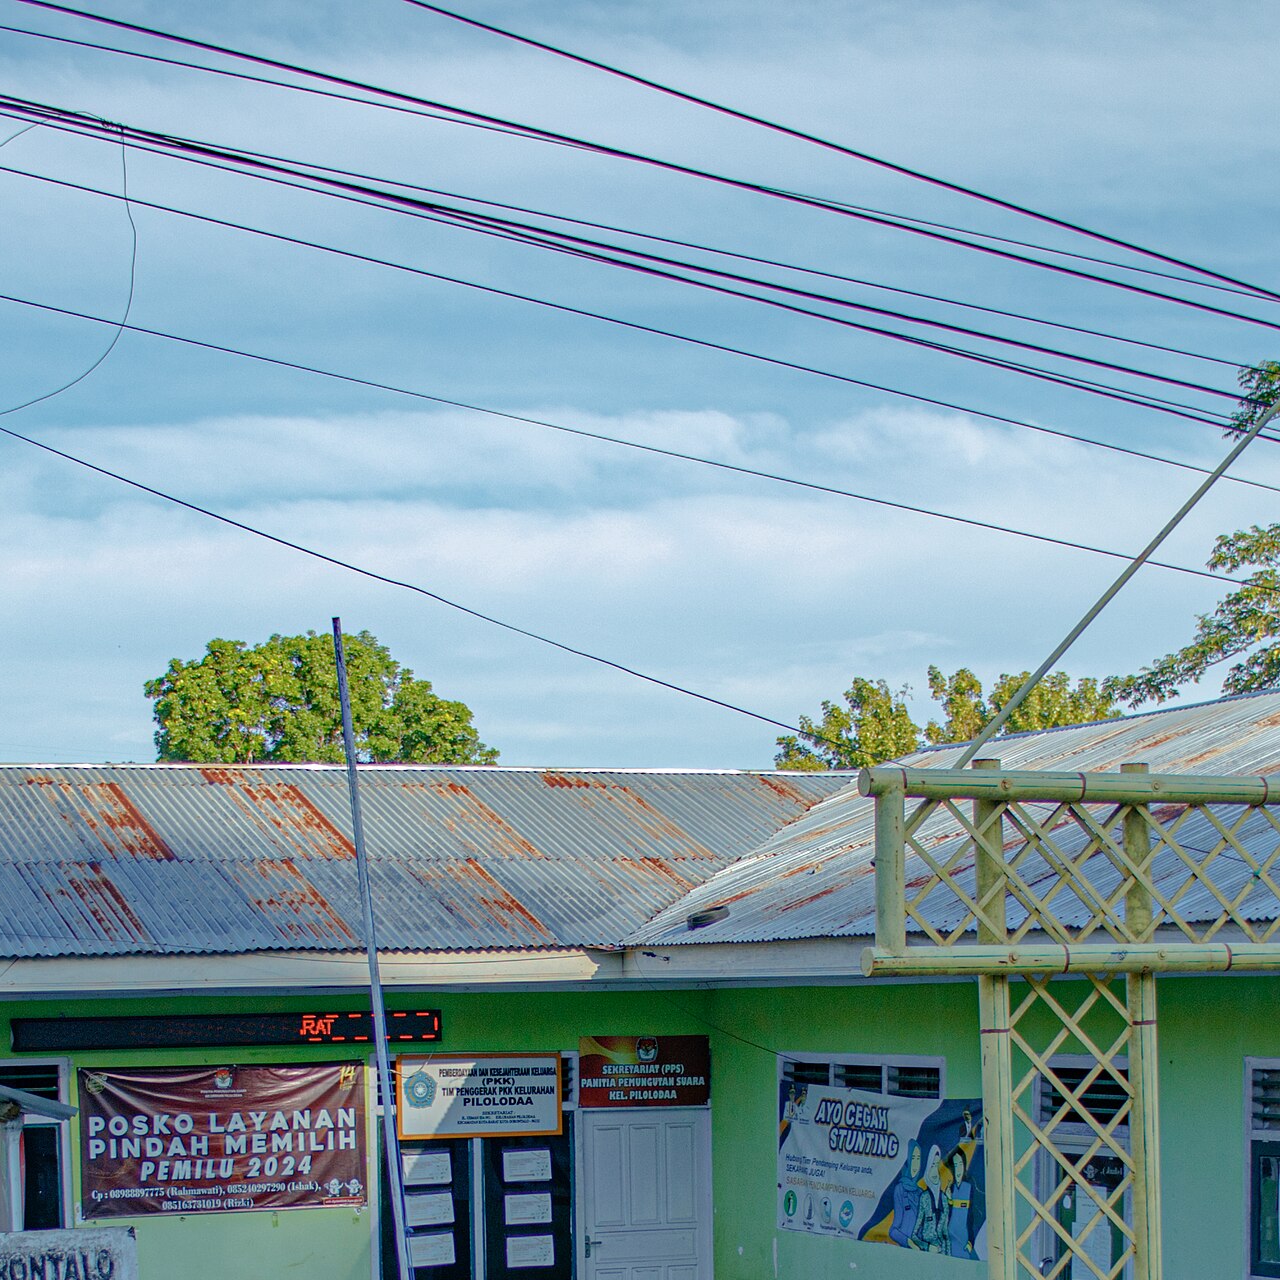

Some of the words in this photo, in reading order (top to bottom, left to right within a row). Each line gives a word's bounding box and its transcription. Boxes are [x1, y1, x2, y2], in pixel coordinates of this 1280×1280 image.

[602, 1065, 660, 1075] SEKRETARIAT
[661, 1064, 684, 1075] (PPS)
[482, 1077, 516, 1086] (PKK)
[581, 1078, 616, 1088] PANITIA
[618, 1077, 674, 1087] PEMUNGUTAN
[676, 1076, 705, 1086] SUARA
[442, 1087, 455, 1096] TIM
[456, 1086, 497, 1096] PENGGERAK
[499, 1086, 513, 1095] PKK
[514, 1085, 555, 1095] KELURAHAN
[609, 1090, 628, 1100] KEL.
[629, 1089, 677, 1100] PILOLODAA
[463, 1096, 534, 1107] PILOLODAA
[814, 1099, 843, 1125] AYO
[844, 1102, 890, 1131] CEGAH
[88, 1113, 195, 1137] POSKO
[209, 1107, 357, 1134] LAYANAN
[88, 1135, 210, 1160] PINDAH
[225, 1129, 357, 1155] MEMILIH
[829, 1126, 899, 1158] STUNTING
[139, 1158, 235, 1183] PEMILU
[247, 1155, 313, 1178] 2024
[223, 1197, 254, 1209] (Rizki)
